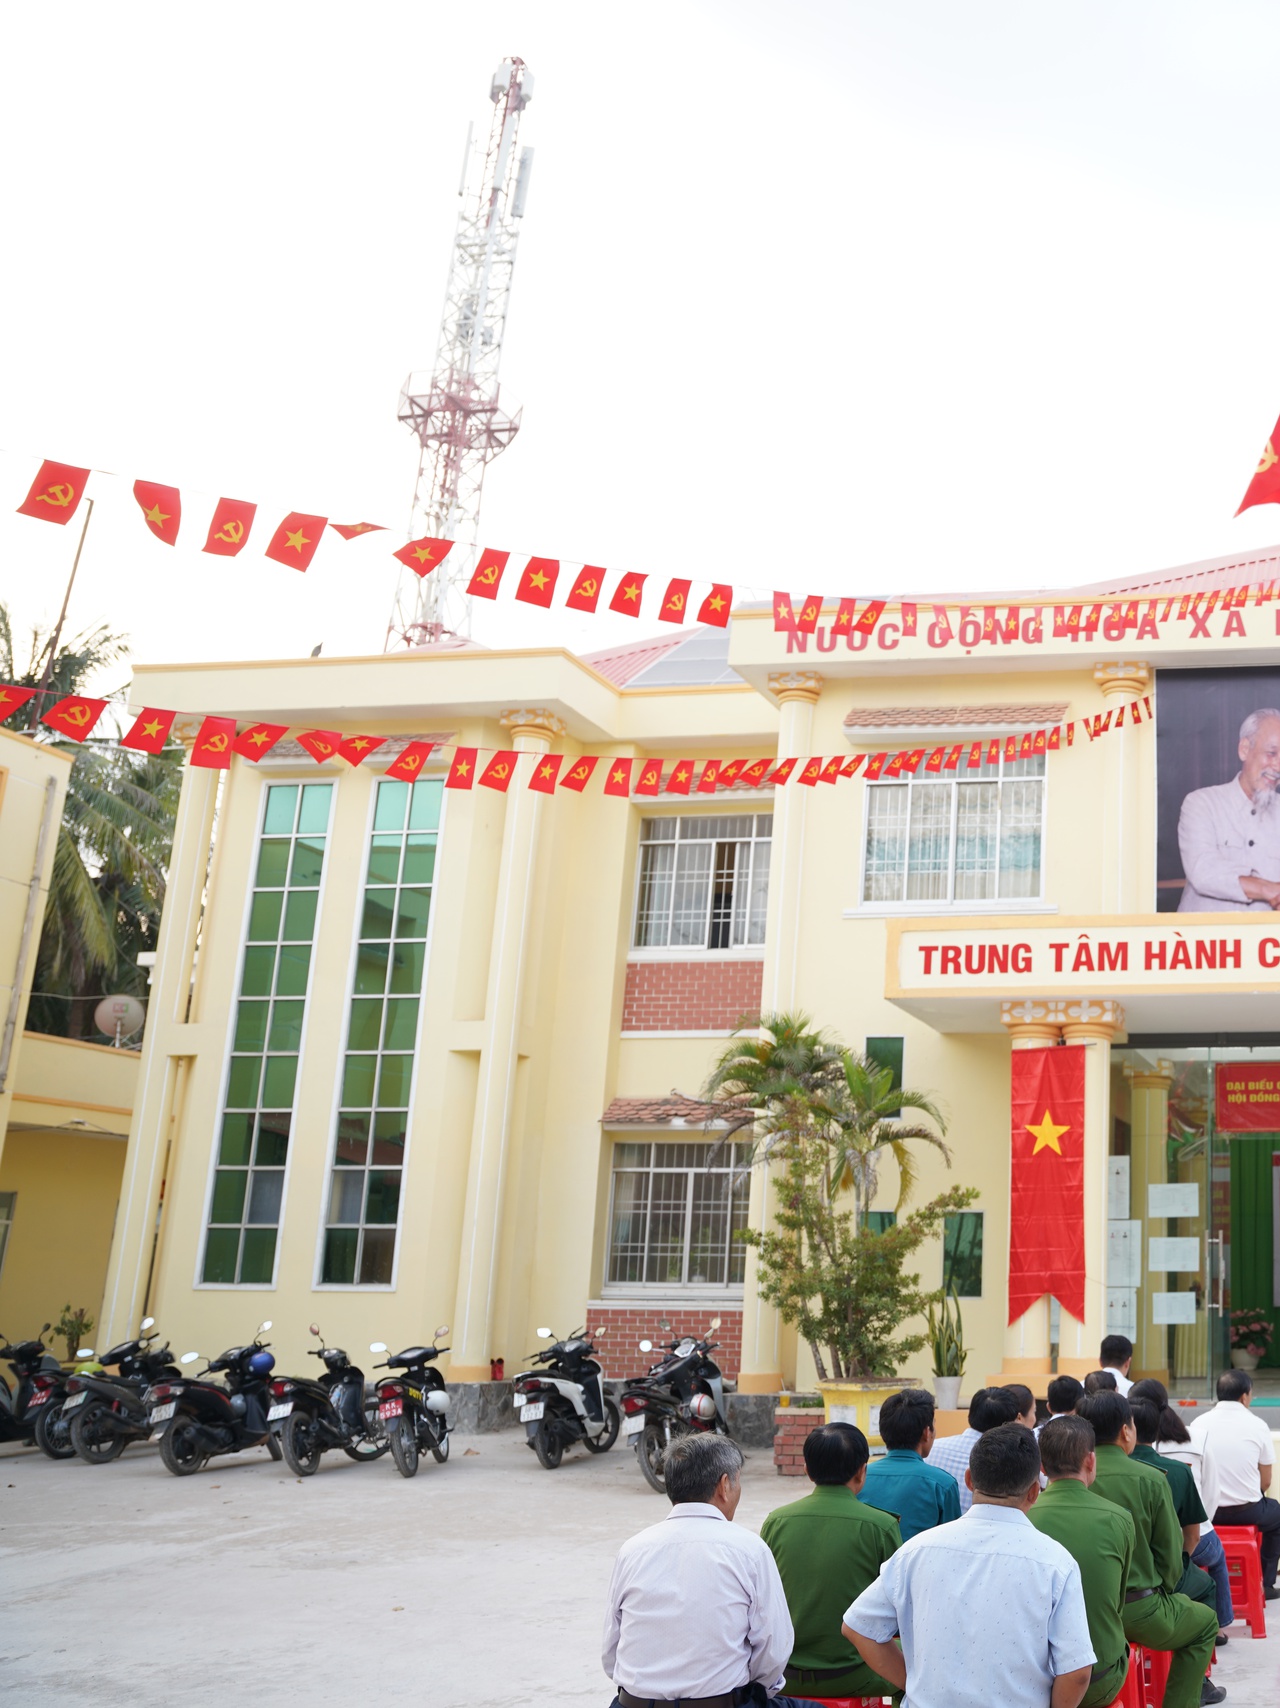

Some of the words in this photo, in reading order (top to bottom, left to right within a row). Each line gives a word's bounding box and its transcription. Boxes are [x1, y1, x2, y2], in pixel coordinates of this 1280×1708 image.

[918, 943, 1033, 975] TRUNG
[1049, 933, 1129, 973] TÂM
[1144, 931, 1242, 970] HÀNH
[1226, 1081, 1245, 1092] ĐẠI
[1227, 1093, 1247, 1105] HỘI
